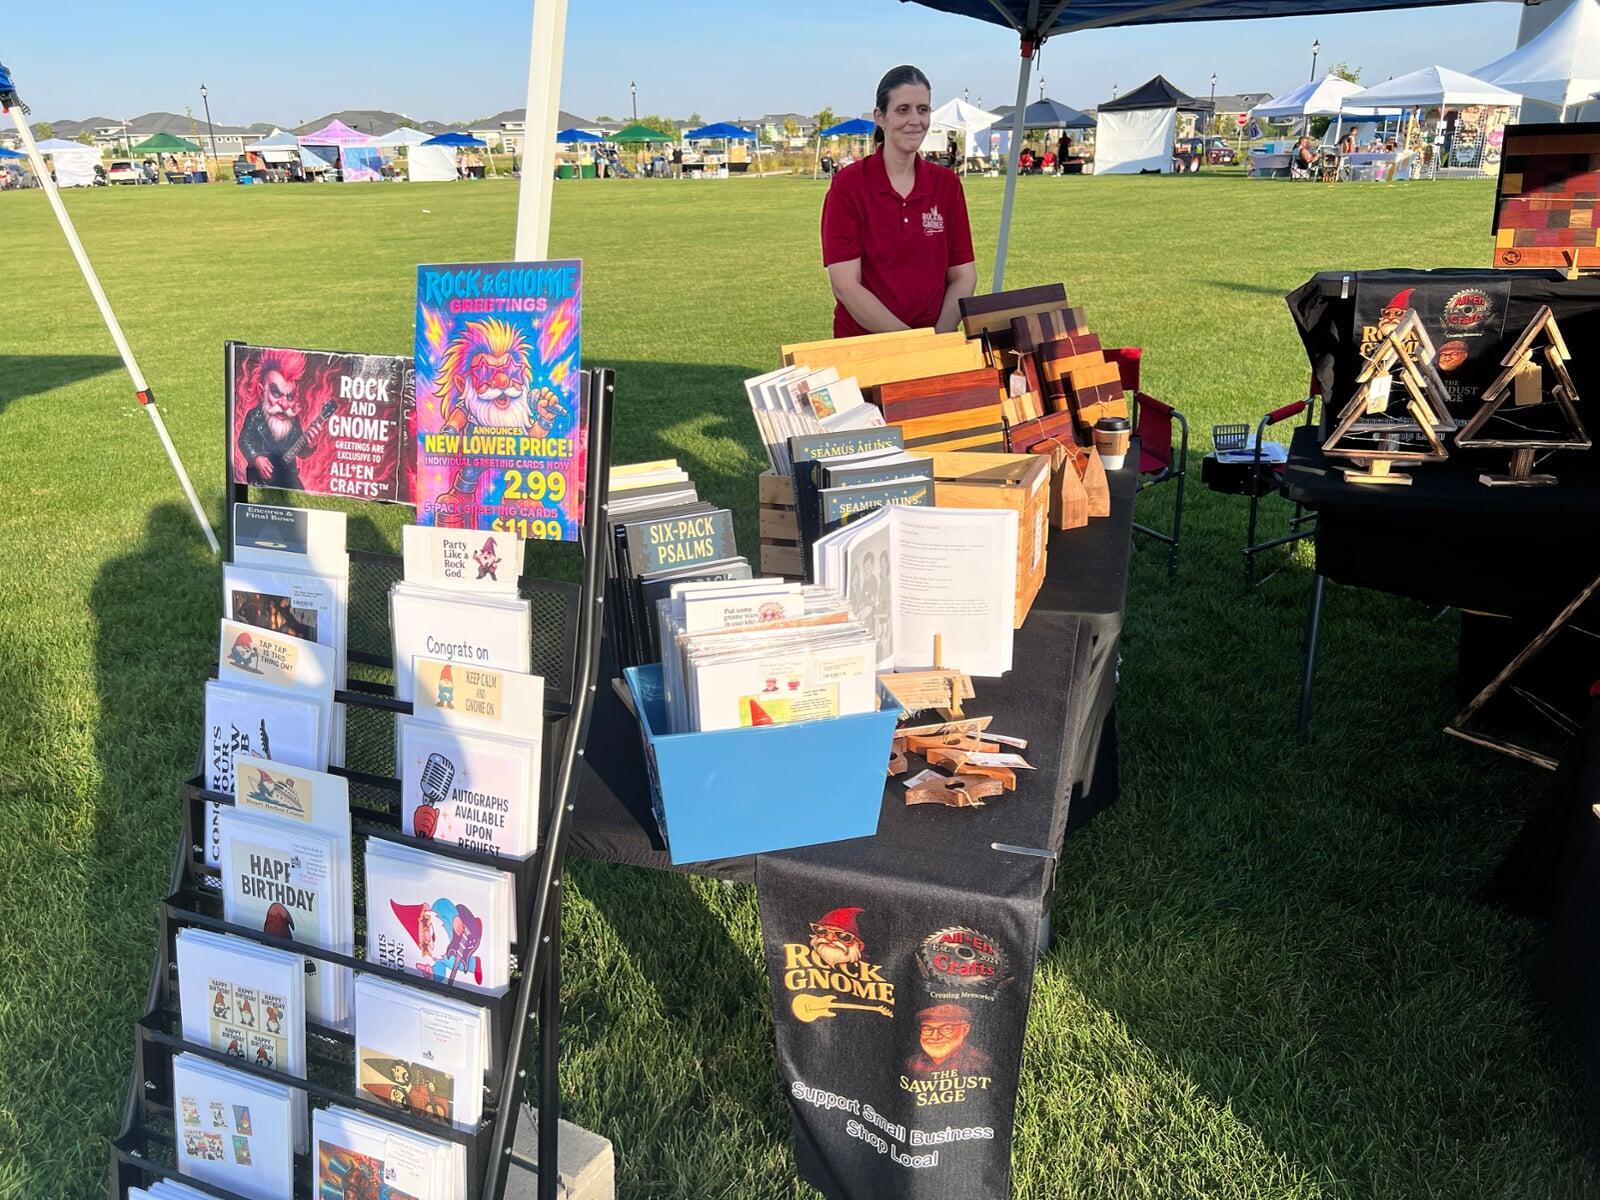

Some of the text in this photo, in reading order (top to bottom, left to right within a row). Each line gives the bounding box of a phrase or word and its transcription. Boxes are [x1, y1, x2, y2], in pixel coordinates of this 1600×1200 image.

[425, 269, 481, 306] ROCK
[495, 267, 577, 299] GNOME
[450, 298, 547, 313] GREETINGS
[340, 375, 390, 402] ROCK
[350, 401, 376, 416] AND
[473, 426, 524, 435] ANNOUNCES
[335, 441, 385, 454] GREETINGS ARE
[425, 435, 574, 458] NEW LOWER PRICE!
[811, 443, 854, 459] SEAMUS
[337, 451, 381, 463] EXCLUSIVE TO
[425, 457, 570, 470] INDIVIDUAL GREETING CARDS NOW
[504, 469, 566, 501] 2.99
[247, 506, 284, 516] Encores
[425, 501, 559, 518] 5-PACK GREETING CARDS
[839, 500, 883, 514] SEAMUS
[246, 512, 295, 523] Final Bows
[650, 517, 715, 544] SIX-PACK
[443, 540, 467, 551] Party
[658, 539, 714, 565] PSALMS
[444, 550, 462, 560] Like
[444, 560, 465, 569] Rock
[259, 640, 272, 649] TAP
[427, 636, 489, 660] Congrats on
[260, 656, 294, 671] THING ON?
[263, 649, 286, 662] IS THIS
[466, 671, 497, 688] KEEP CALM
[476, 689, 485, 699] AND
[466, 699, 495, 715] GNOME ON
[222, 742, 230, 795] OUR
[452, 788, 509, 812] AUTOGRAPHS
[455, 805, 505, 828] AVAILABLE
[465, 823, 492, 841] UPON
[241, 875, 315, 912] BIRTHDAY
[934, 954, 996, 976] Crafts
[784, 969, 895, 1005] GNOME
[930, 991, 995, 1001] Creating Memories
[932, 1069, 958, 1079] THE
[900, 1075, 991, 1093] SAWDUST
[916, 1090, 967, 1107] SAGE
[791, 1081, 994, 1146] Support Small Business
[846, 1119, 939, 1168] Shop Local
